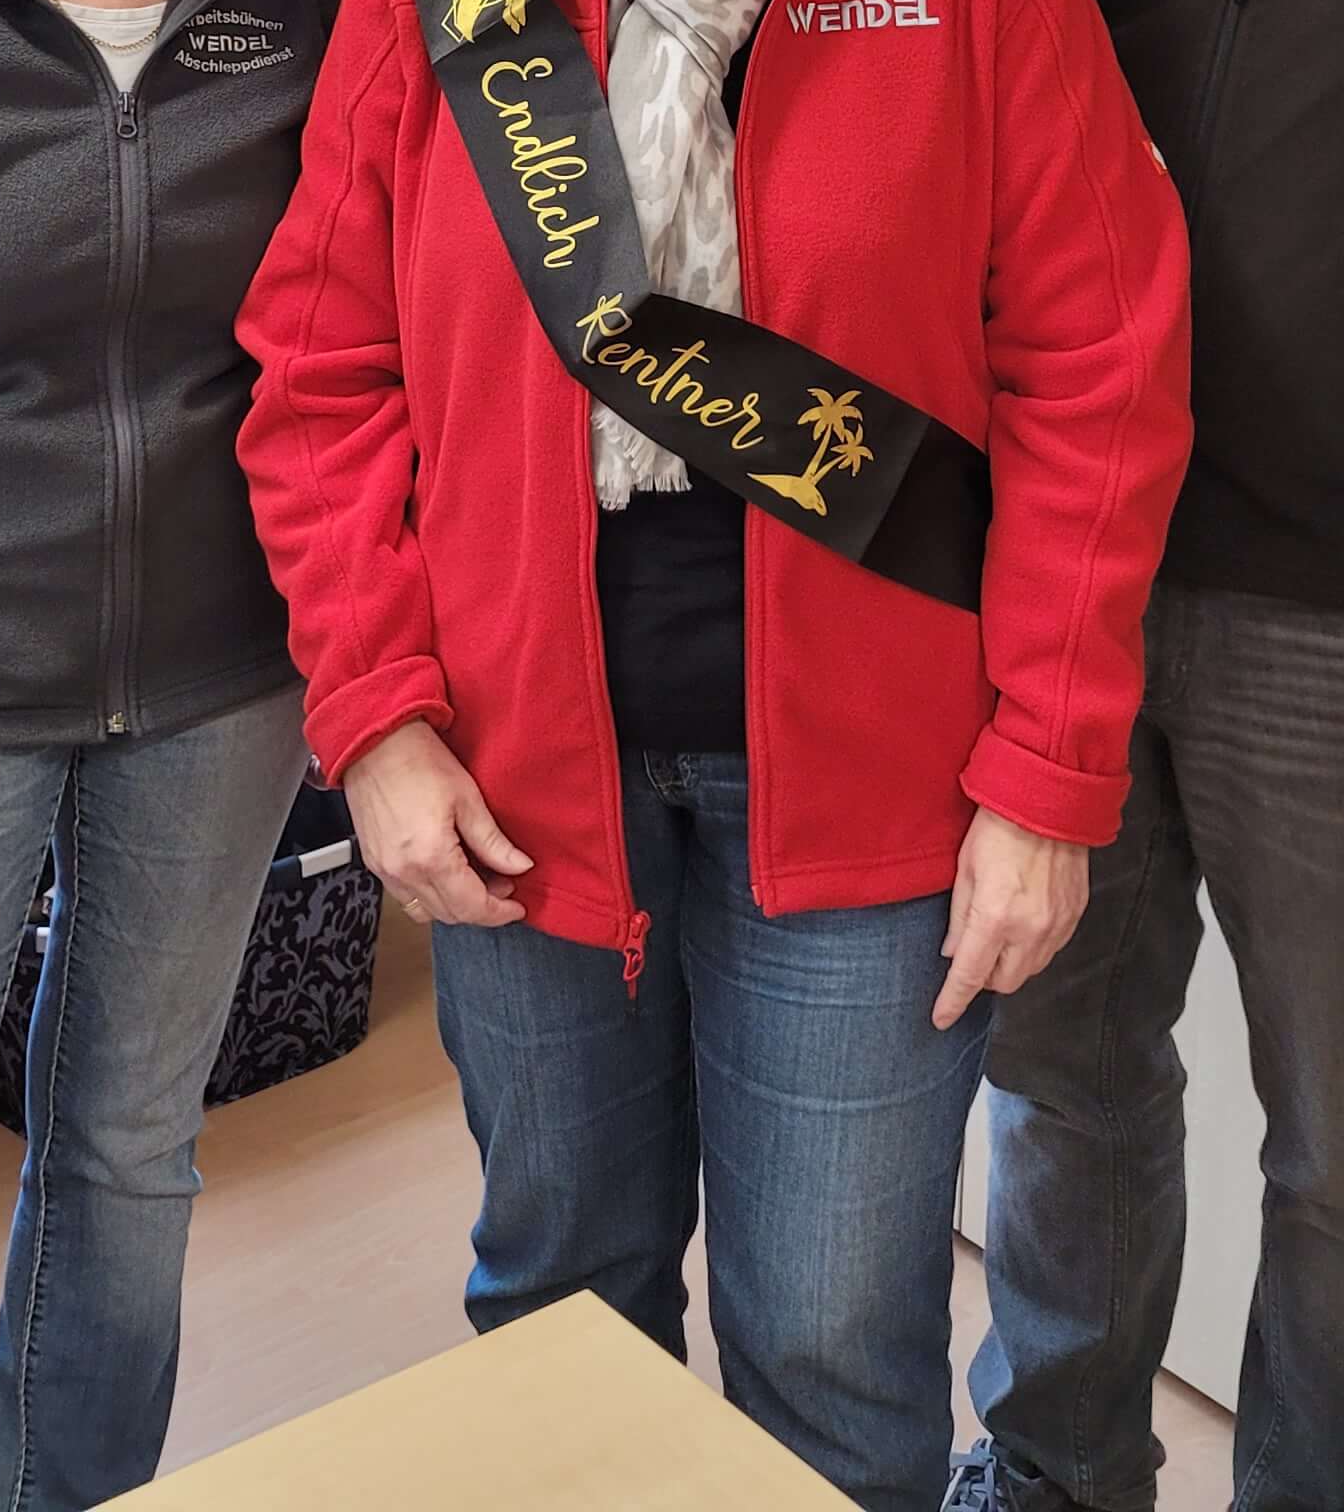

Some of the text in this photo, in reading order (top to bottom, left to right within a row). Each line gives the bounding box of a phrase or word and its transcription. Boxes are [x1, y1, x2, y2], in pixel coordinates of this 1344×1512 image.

[188, 32, 274, 53] WENDEL
[173, 46, 296, 75] Abschleppdienst
[482, 56, 764, 451] Endlich Rentner
